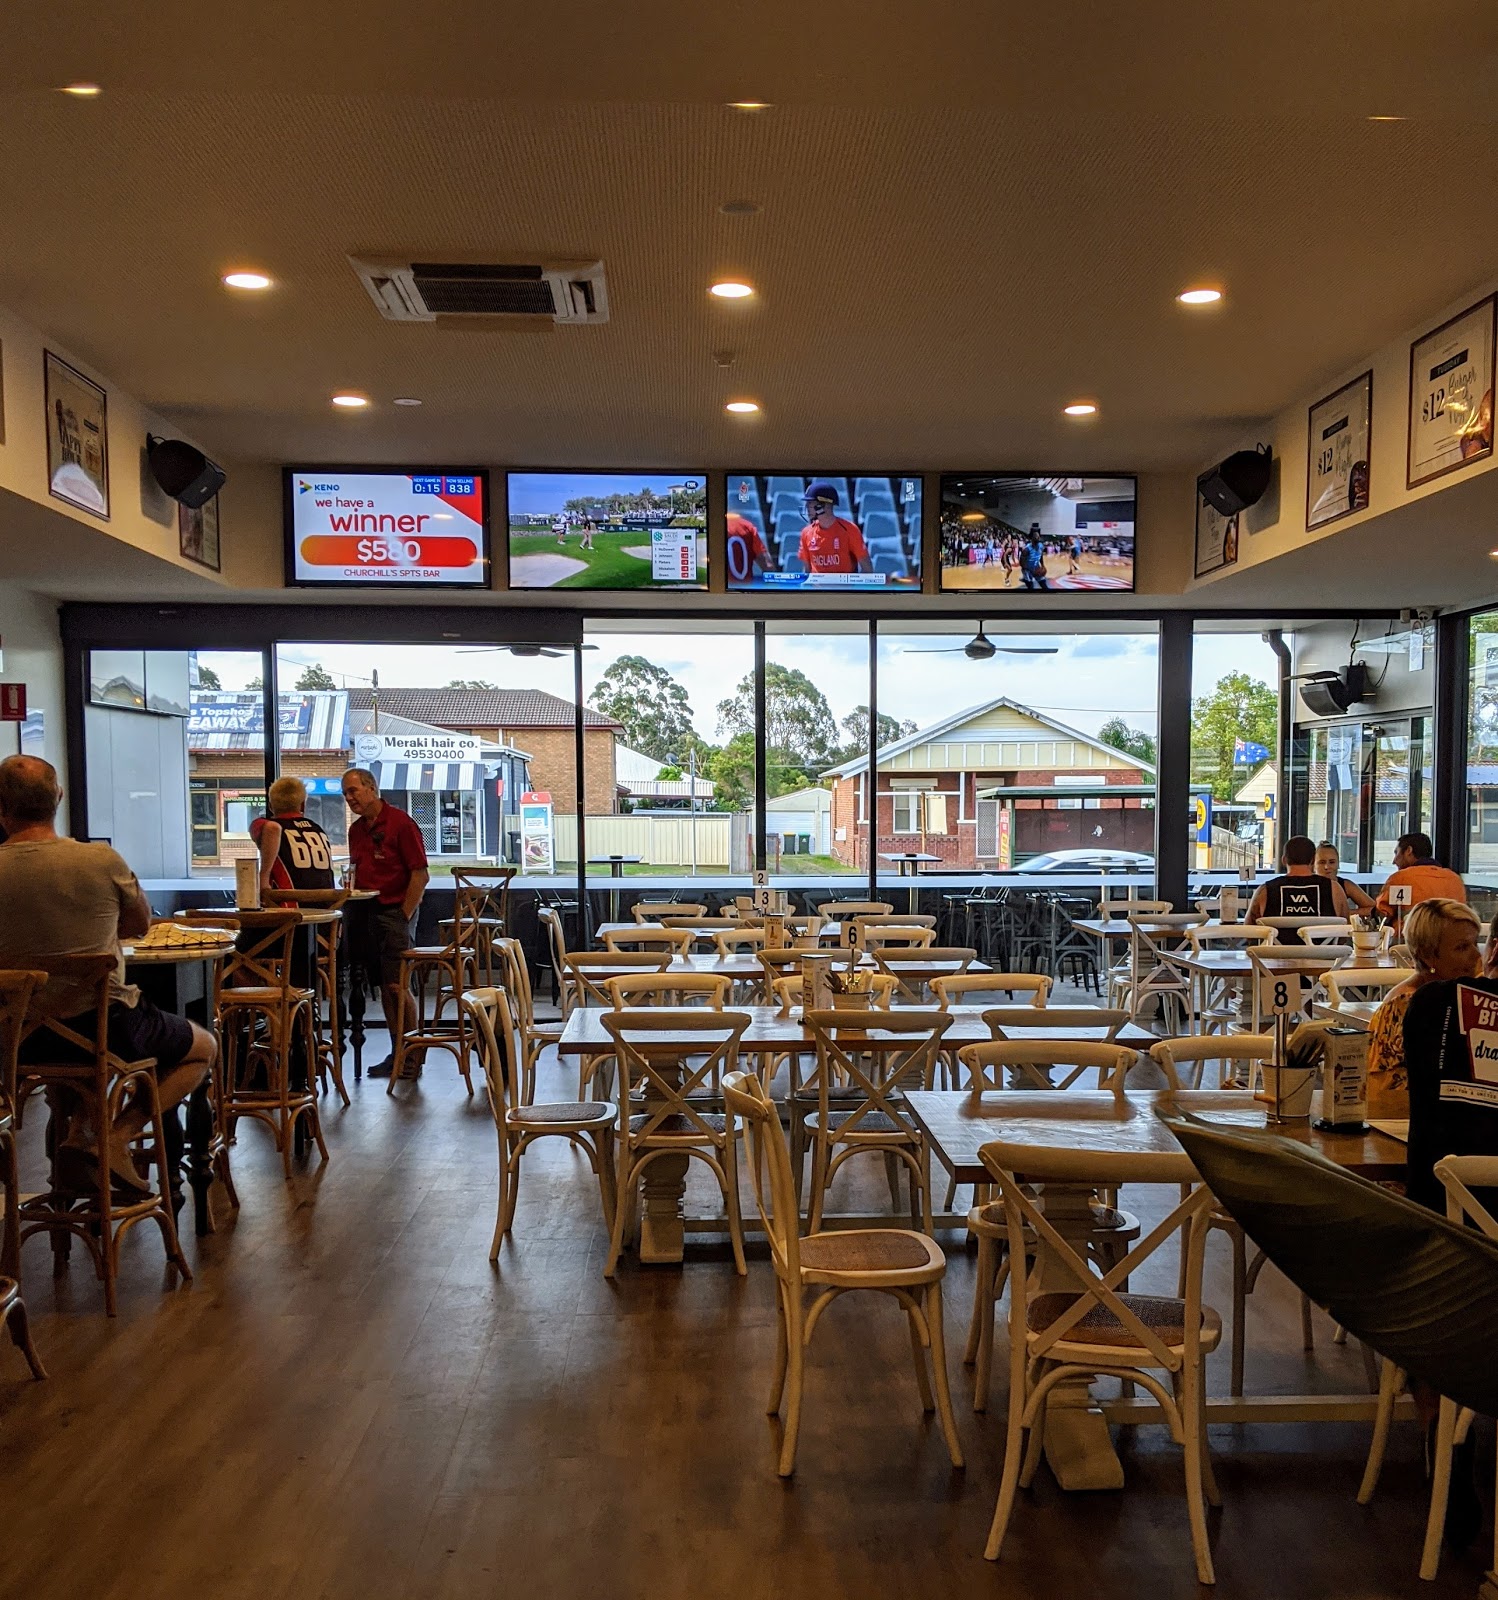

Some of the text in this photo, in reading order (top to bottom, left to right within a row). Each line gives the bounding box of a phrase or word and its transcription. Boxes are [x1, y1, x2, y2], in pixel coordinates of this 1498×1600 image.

[1422, 388, 1445, 422] $12
[414, 484, 440, 492] 0:15
[450, 484, 470, 493] 838
[336, 497, 363, 508] have
[330, 508, 430, 532] winner
[358, 539, 421, 562] $580
[812, 554, 840, 566] ENGLAND
[384, 736, 478, 748] Meraki hair co.
[404, 750, 464, 759] 49530400
[758, 872, 764, 884] 2
[1245, 868, 1250, 878] 1
[762, 892, 768, 904] 3
[1290, 894, 1309, 902] VA
[1396, 889, 1404, 902] 4
[848, 926, 858, 944] 6
[1274, 981, 1288, 1008] 8
[1473, 994, 1498, 1010] VIC
[1478, 1009, 1498, 1026] BI
[1474, 1040, 1498, 1060] dra
